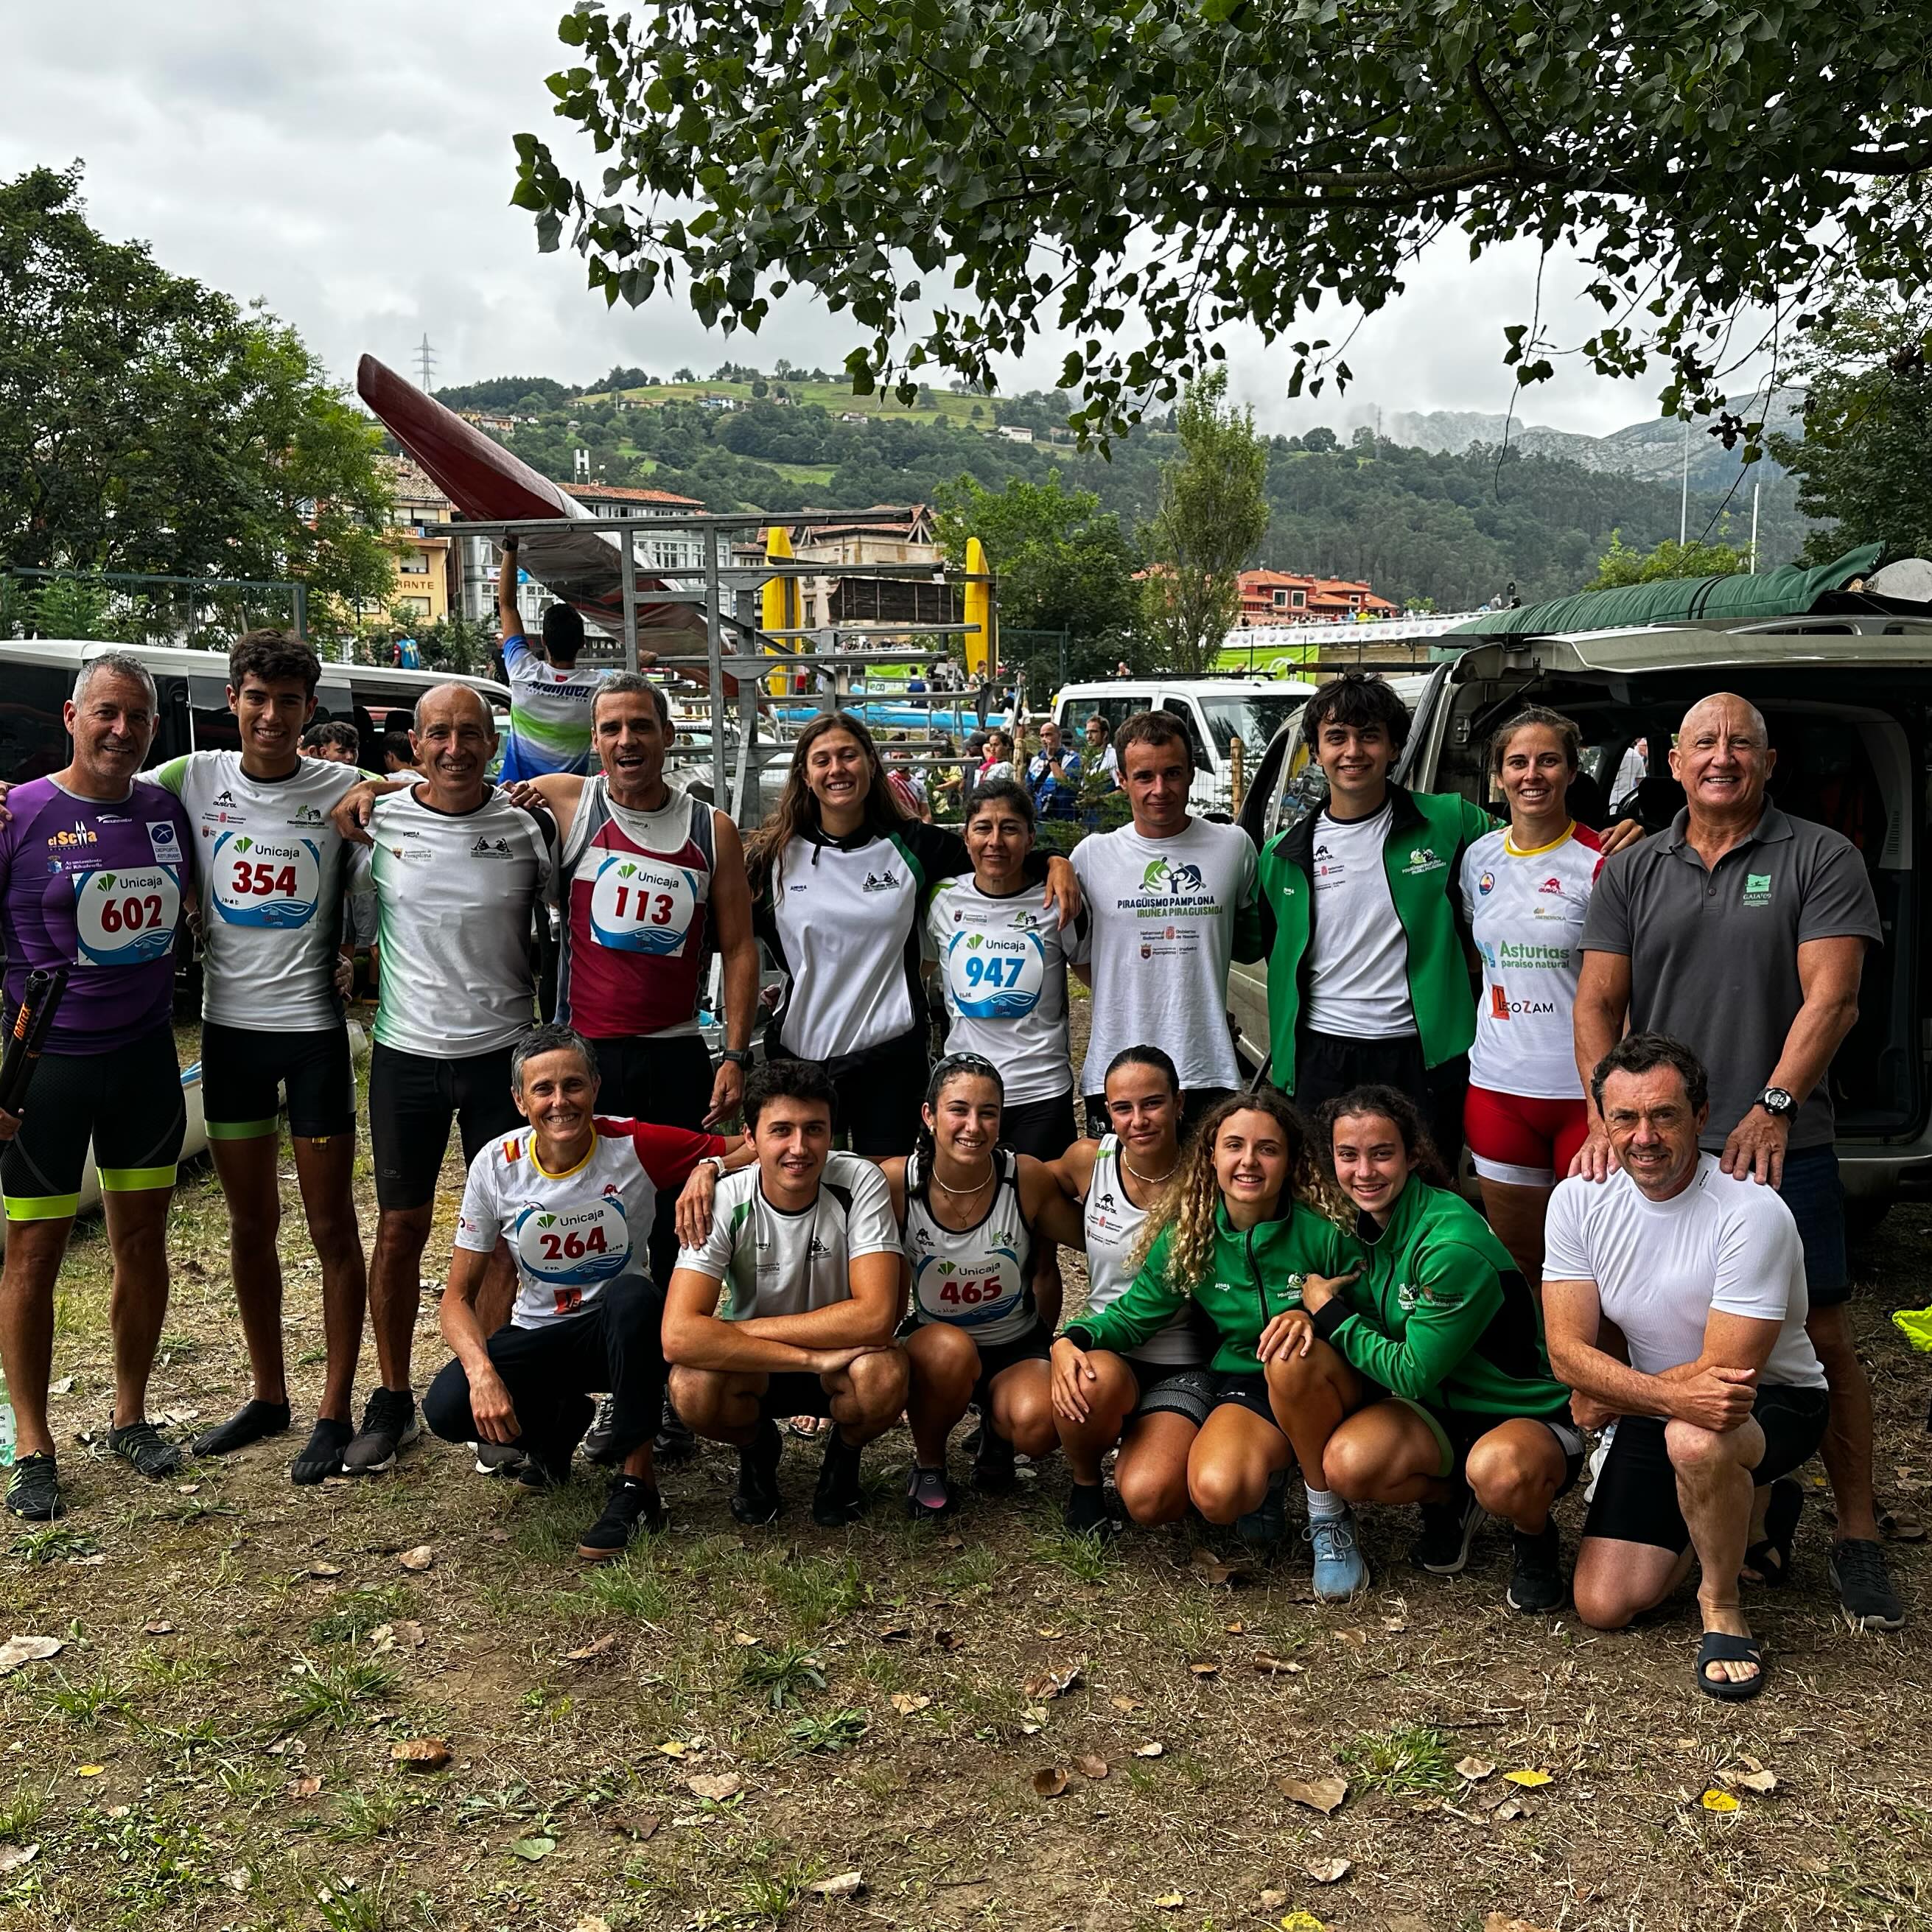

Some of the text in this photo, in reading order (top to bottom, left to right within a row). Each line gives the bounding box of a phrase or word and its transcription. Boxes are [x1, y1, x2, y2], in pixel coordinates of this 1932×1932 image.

[528, 681, 591, 699] Aranjuez
[256, 844, 300, 860] Unicaja
[119, 875, 163, 889] Unicaja
[232, 861, 298, 897] 354
[638, 871, 679, 889] Unicaja
[615, 886, 674, 925] 113
[1117, 895, 1215, 909] PIRAGÜISMO PAMPLONA
[101, 895, 163, 933] 602
[986, 939, 1026, 953] Unicaja
[1500, 939, 1569, 959] Asturias
[965, 957, 1026, 988] 947
[1536, 960, 1569, 968] natural
[560, 1209, 604, 1227] Unicaja
[539, 1226, 608, 1261] 264
[959, 1262, 1001, 1276] Unicaja
[939, 1275, 1004, 1305] 465
